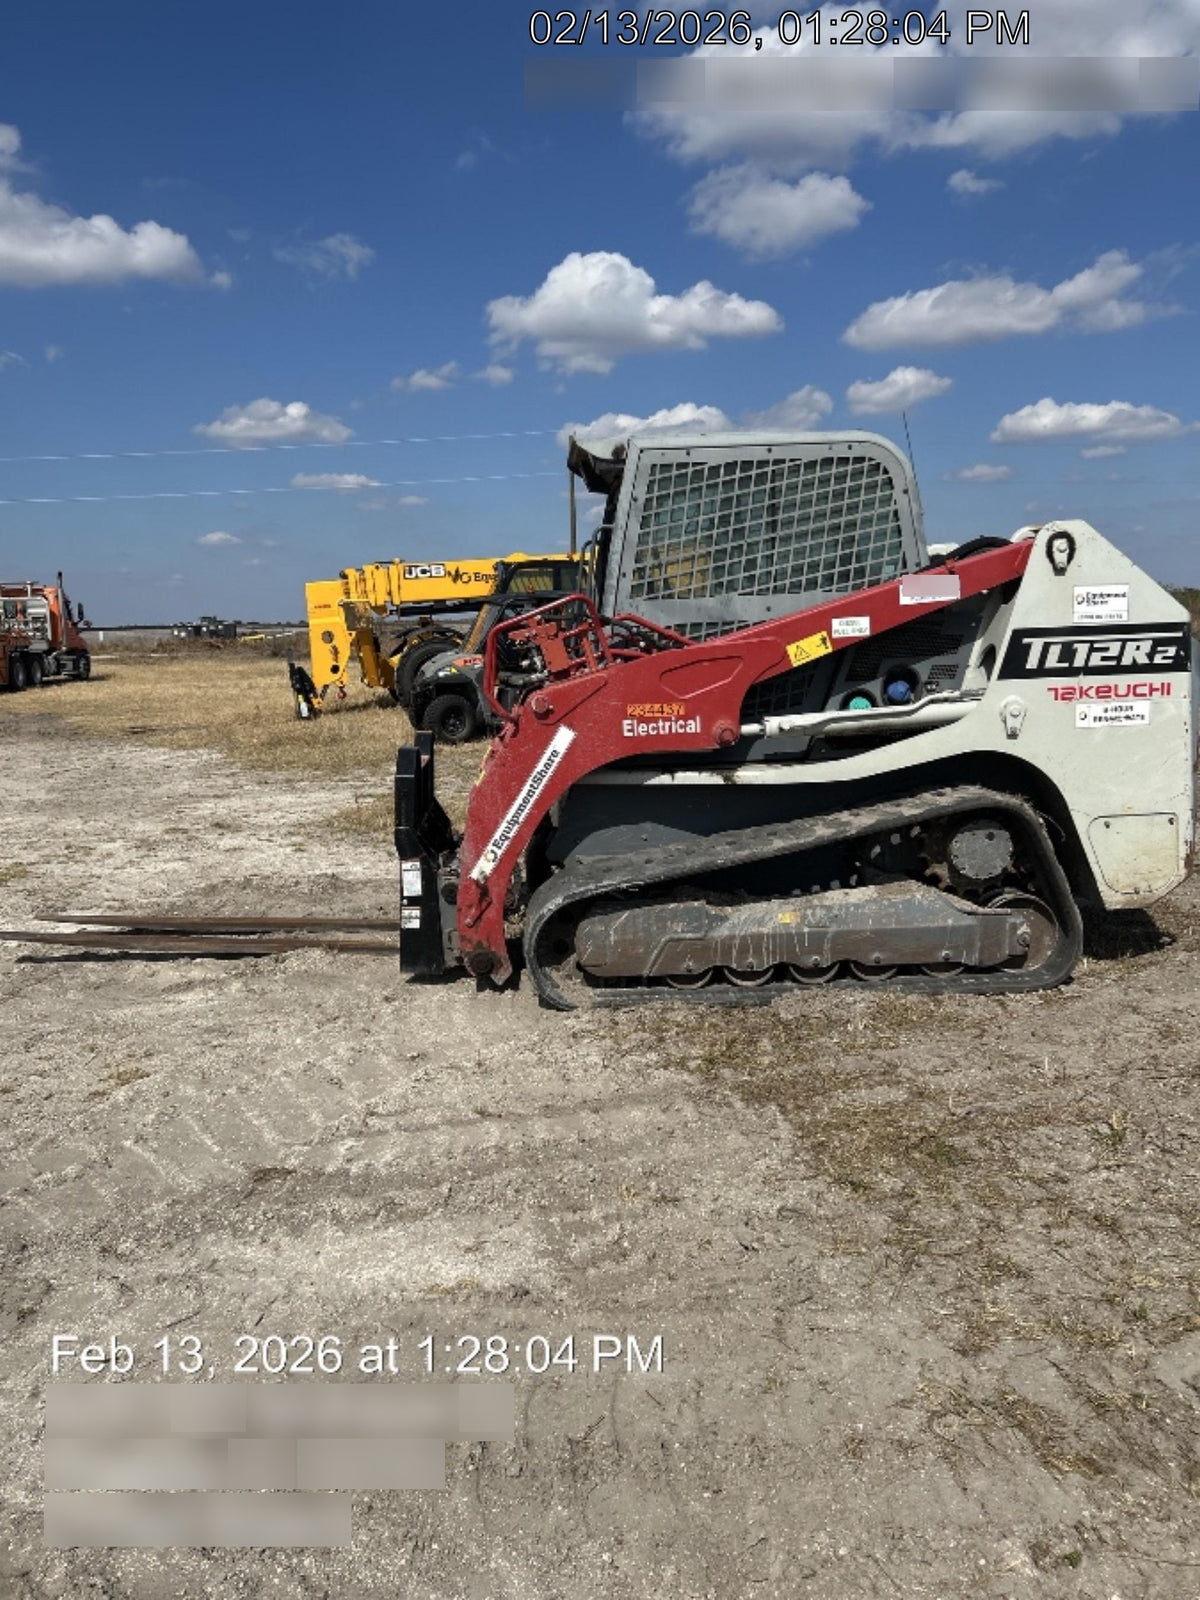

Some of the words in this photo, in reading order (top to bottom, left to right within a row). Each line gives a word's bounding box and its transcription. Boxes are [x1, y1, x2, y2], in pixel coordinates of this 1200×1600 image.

[405, 565, 445, 578] JCB
[622, 715, 702, 737] Electrical
[491, 749, 560, 851] EquipmentShare
